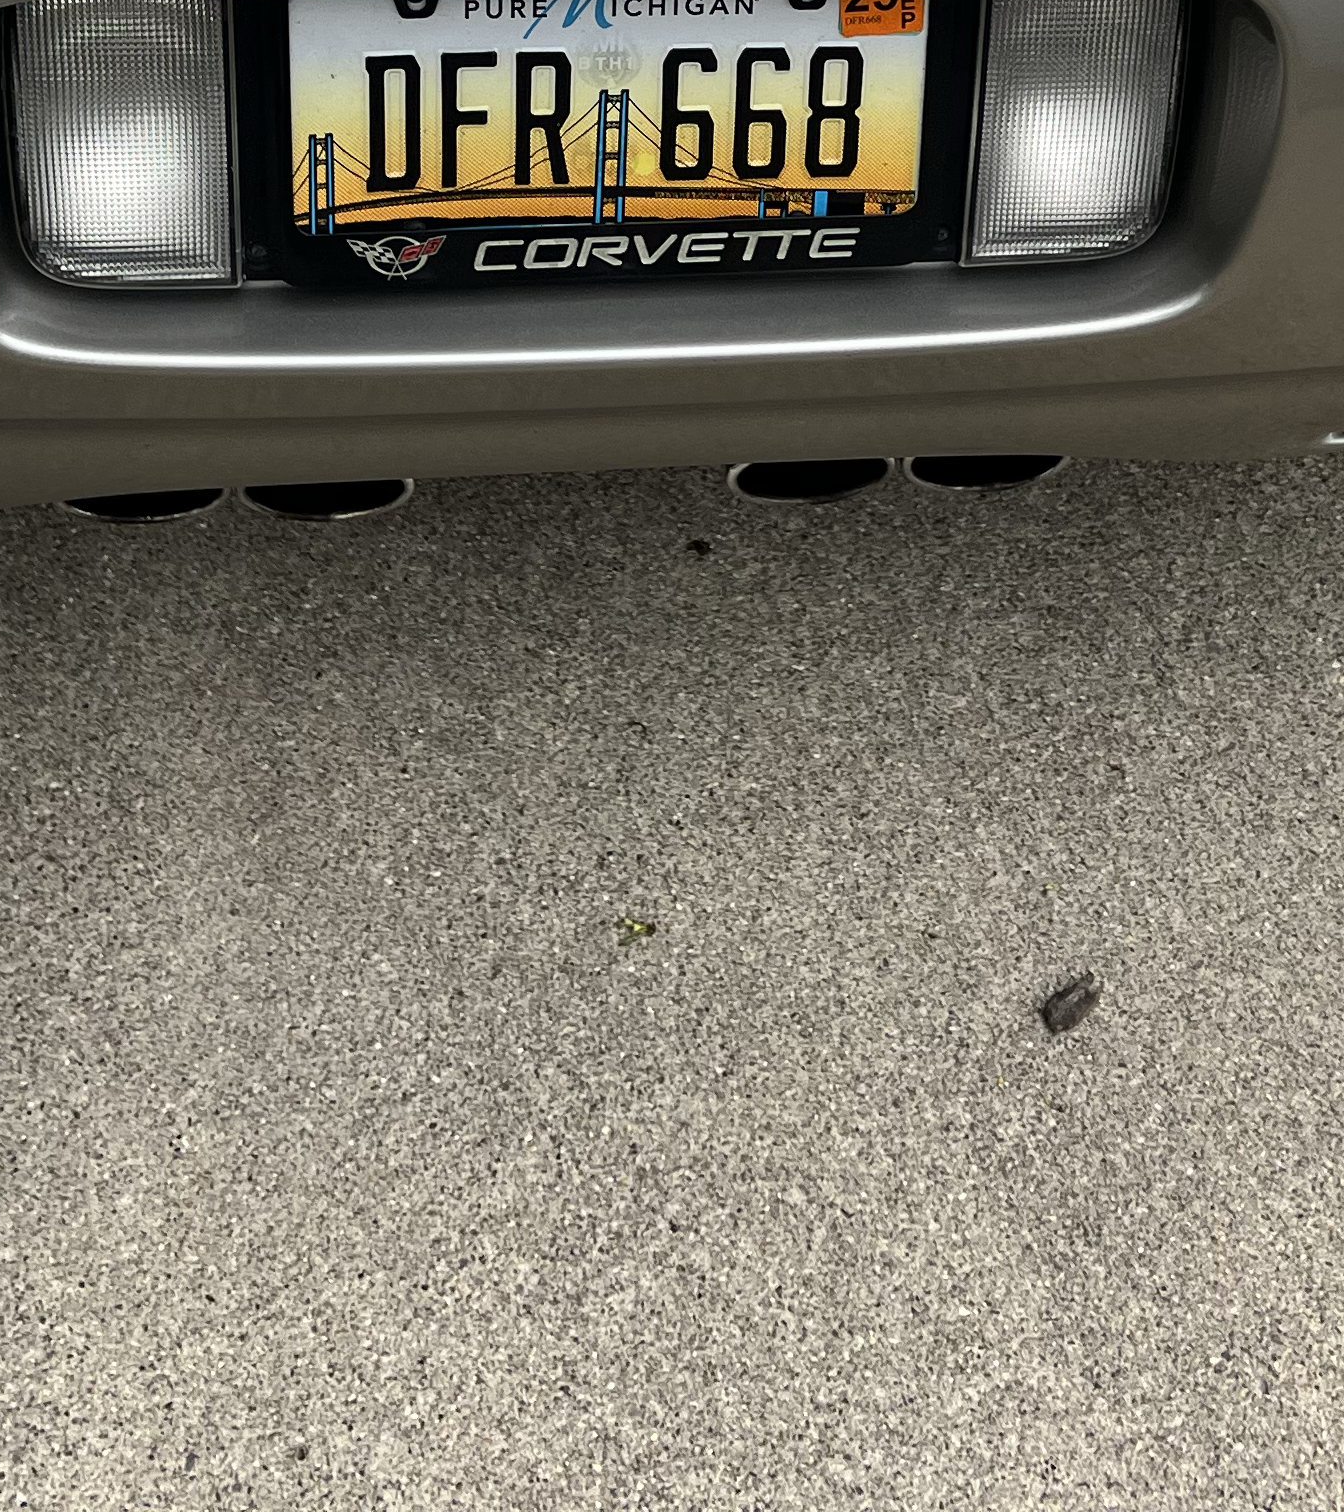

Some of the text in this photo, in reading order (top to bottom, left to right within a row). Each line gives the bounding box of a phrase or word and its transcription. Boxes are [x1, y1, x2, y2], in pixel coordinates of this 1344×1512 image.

[844, 15, 882, 26] DFR668
[365, 46, 864, 192] DFR 668
[473, 227, 860, 272] CORVETTE
